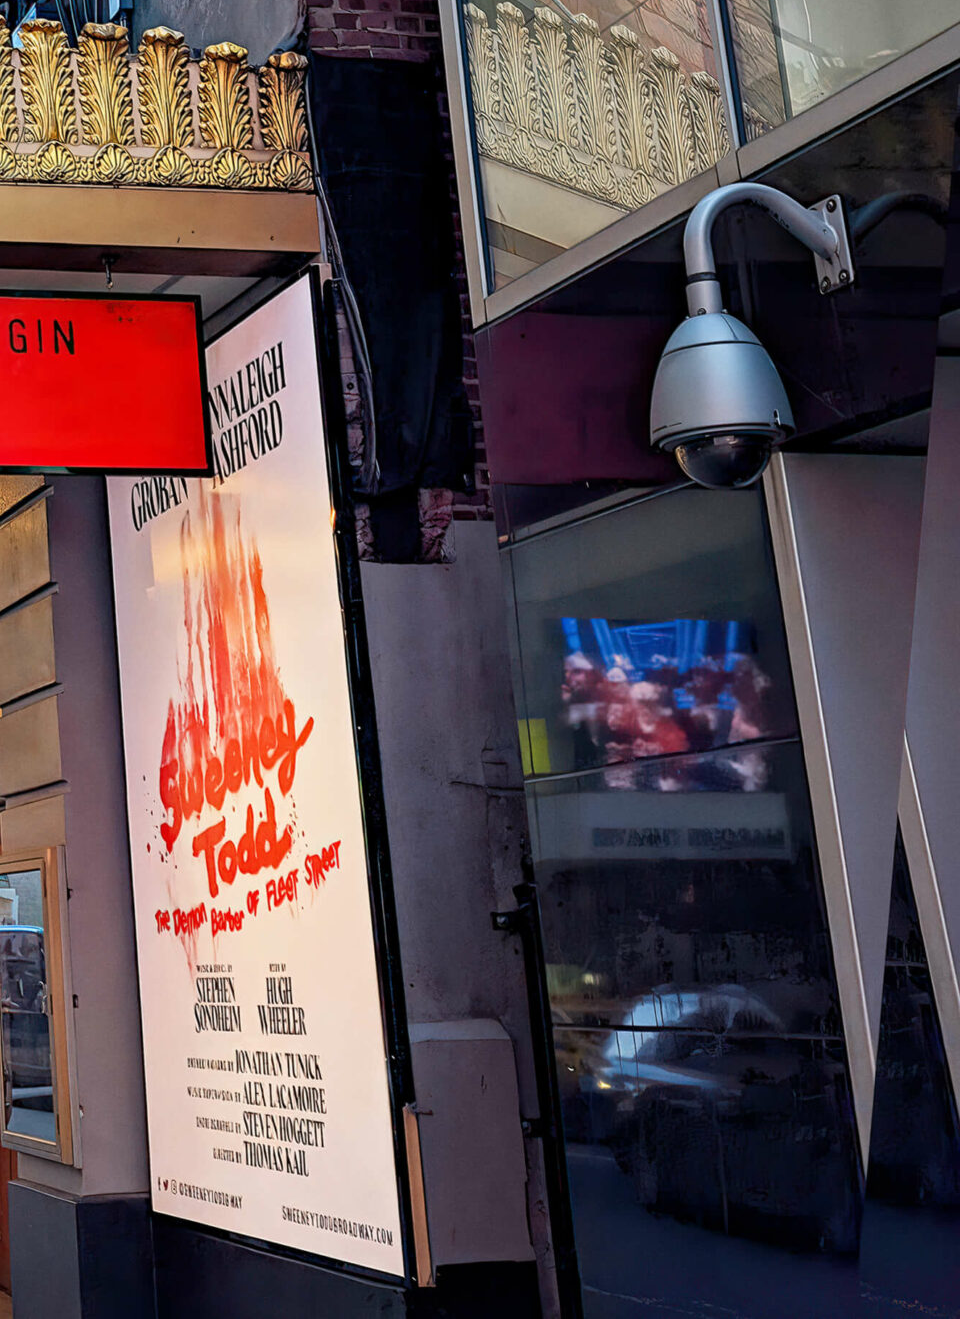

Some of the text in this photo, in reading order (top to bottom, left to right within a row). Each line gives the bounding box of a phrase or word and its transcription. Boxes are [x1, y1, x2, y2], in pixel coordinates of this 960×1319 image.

[208, 341, 287, 430] NNALEIGH
[212, 399, 284, 490] ASHFORD
[131, 476, 189, 532] GROBAN
[192, 787, 294, 899] Todd
[195, 976, 237, 1004] STEPHEN
[265, 976, 294, 1006] HUGH
[193, 1002, 242, 1034] SONDHEIM
[257, 1004, 307, 1036] WHEELER
[234, 1048, 283, 1077] JONATHAN
[284, 1052, 323, 1081] TUNICK
[243, 1080, 267, 1107] ALEX
[268, 1082, 327, 1115] LACAMOIRE
[242, 1110, 279, 1141] STEVEN
[278, 1114, 326, 1149] HOGGETT
[243, 1140, 285, 1173] THOMAS
[284, 1146, 310, 1178] KAIL
